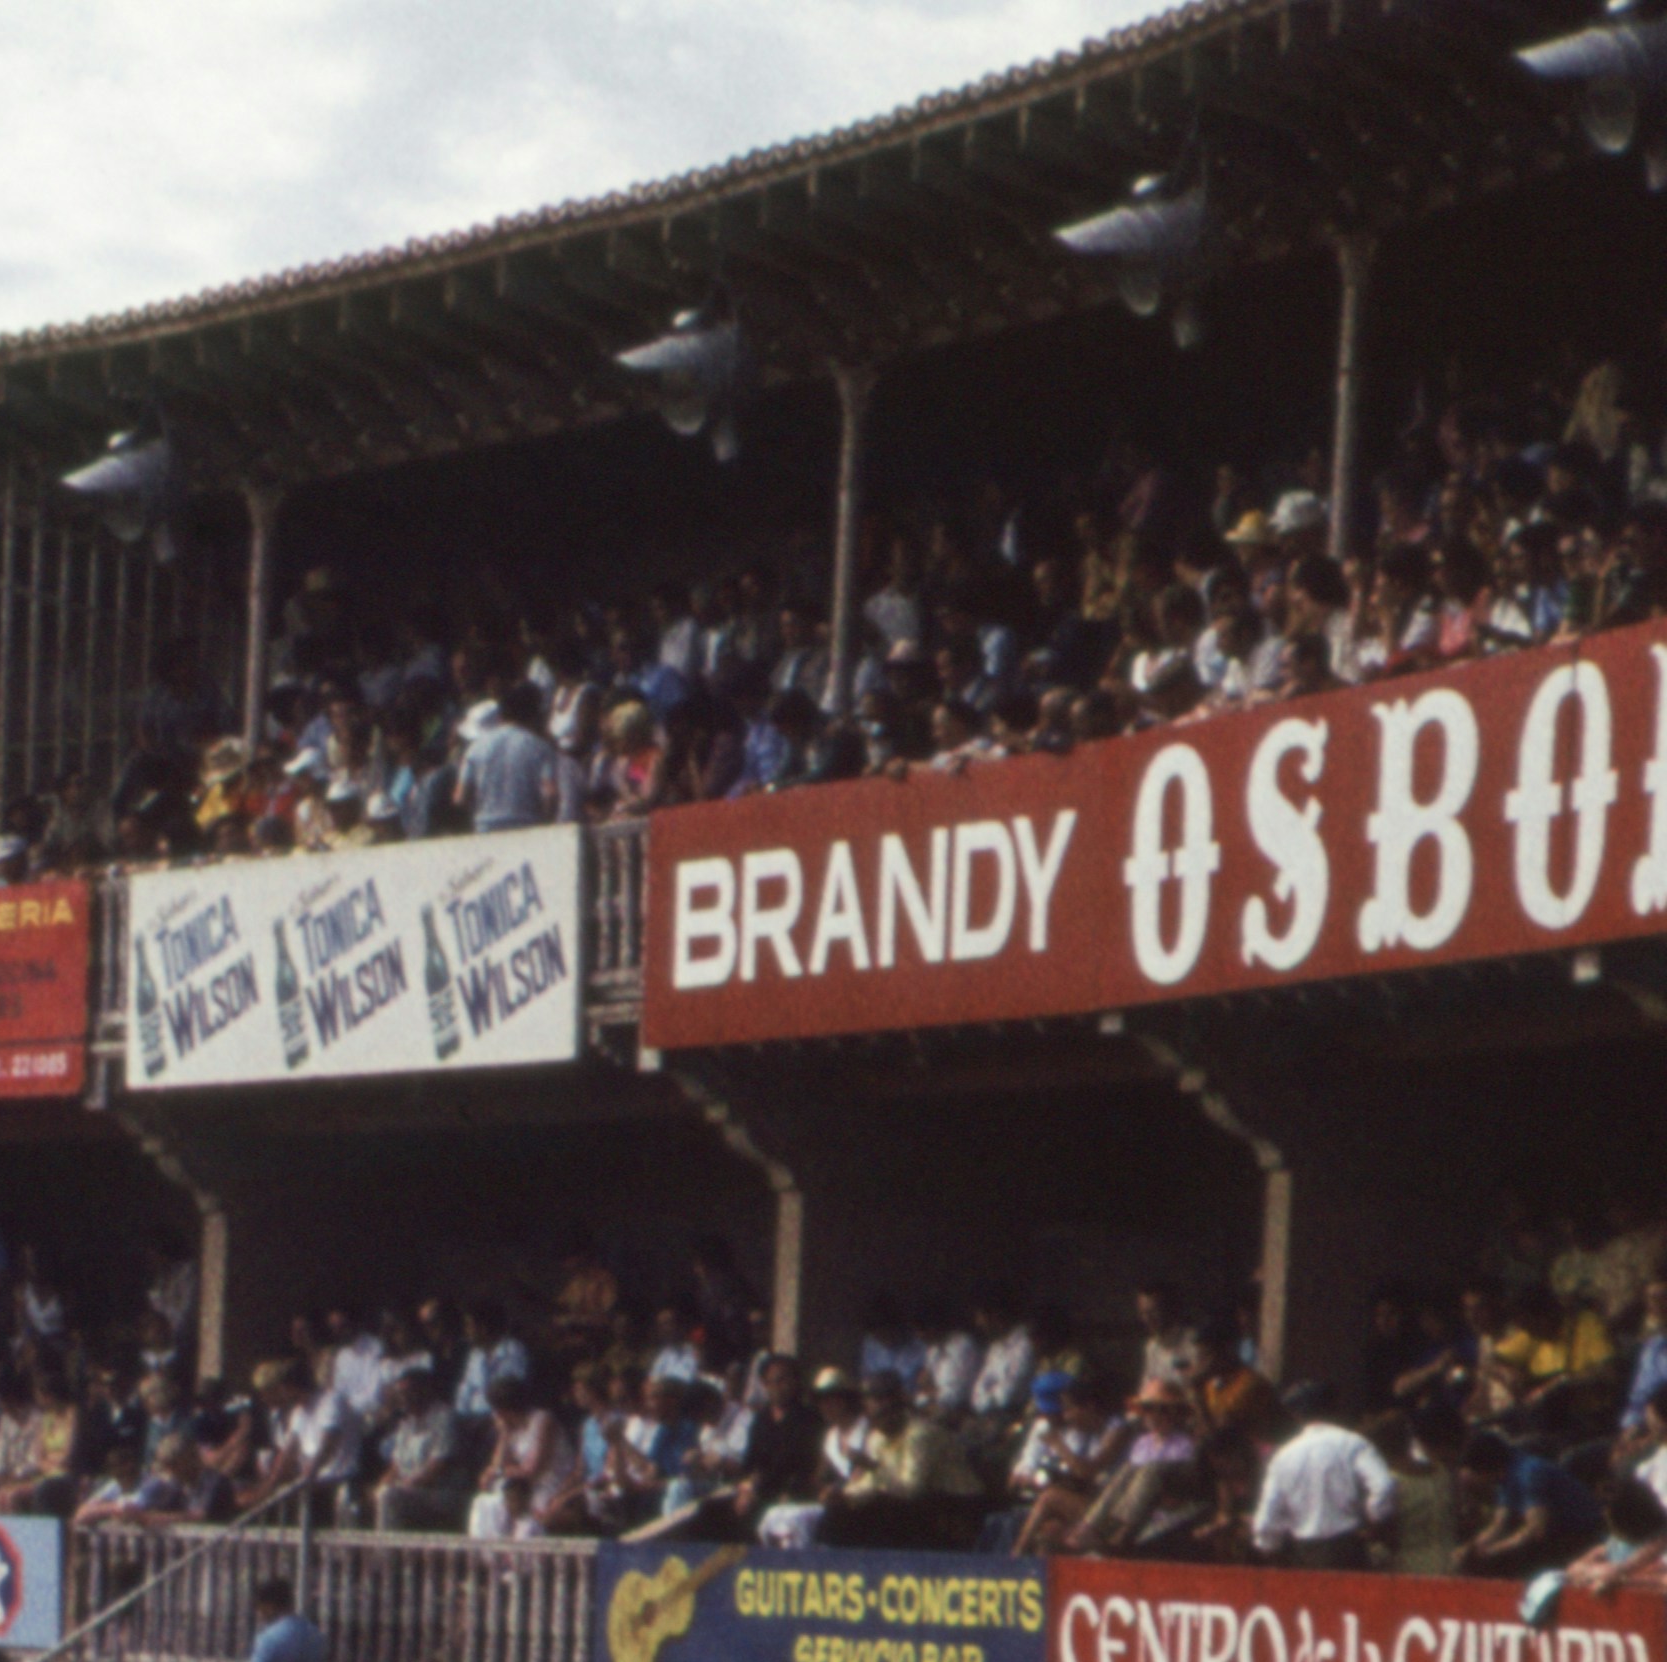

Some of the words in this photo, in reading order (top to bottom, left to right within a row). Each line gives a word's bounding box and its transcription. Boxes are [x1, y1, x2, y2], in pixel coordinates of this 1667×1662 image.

[157, 895, 239, 990] TONICA
[296, 877, 386, 976] TONICA
[446, 861, 545, 965] TONICA
[673, 810, 1076, 990] BRANDY
[164, 952, 260, 1059] WILSON
[306, 937, 408, 1050] WILSON
[457, 922, 568, 1040] WILSON
